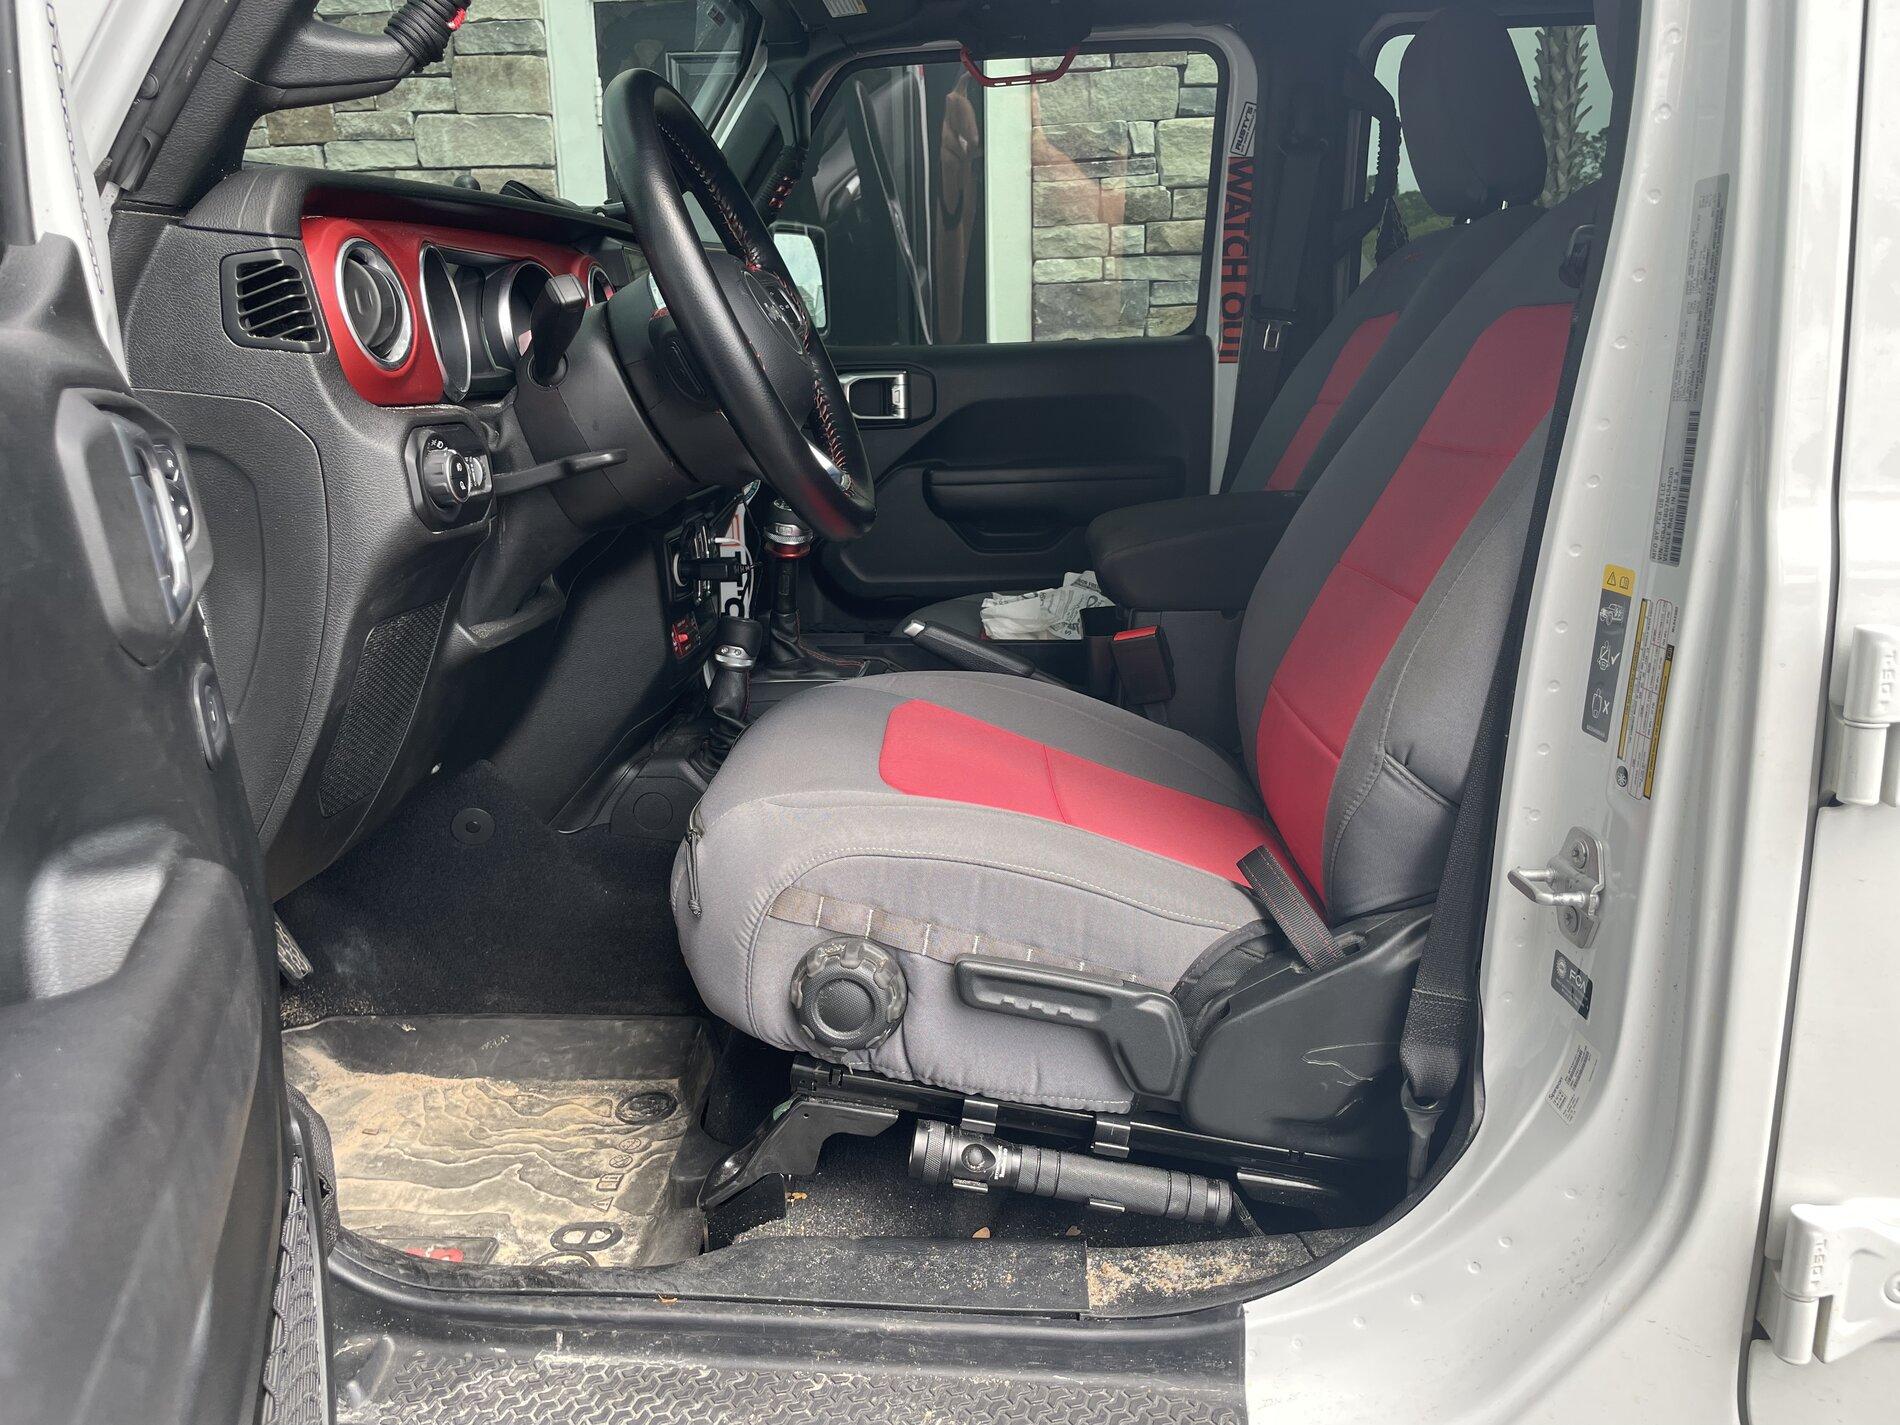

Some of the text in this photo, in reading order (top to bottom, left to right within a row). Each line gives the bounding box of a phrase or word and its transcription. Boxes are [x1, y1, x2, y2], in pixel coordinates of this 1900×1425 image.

[1235, 106, 1253, 151] RUSTY'S
[1222, 157, 1254, 284] WATCH
[1667, 506, 1675, 528] MADE
[1569, 969, 1587, 993] FCA
